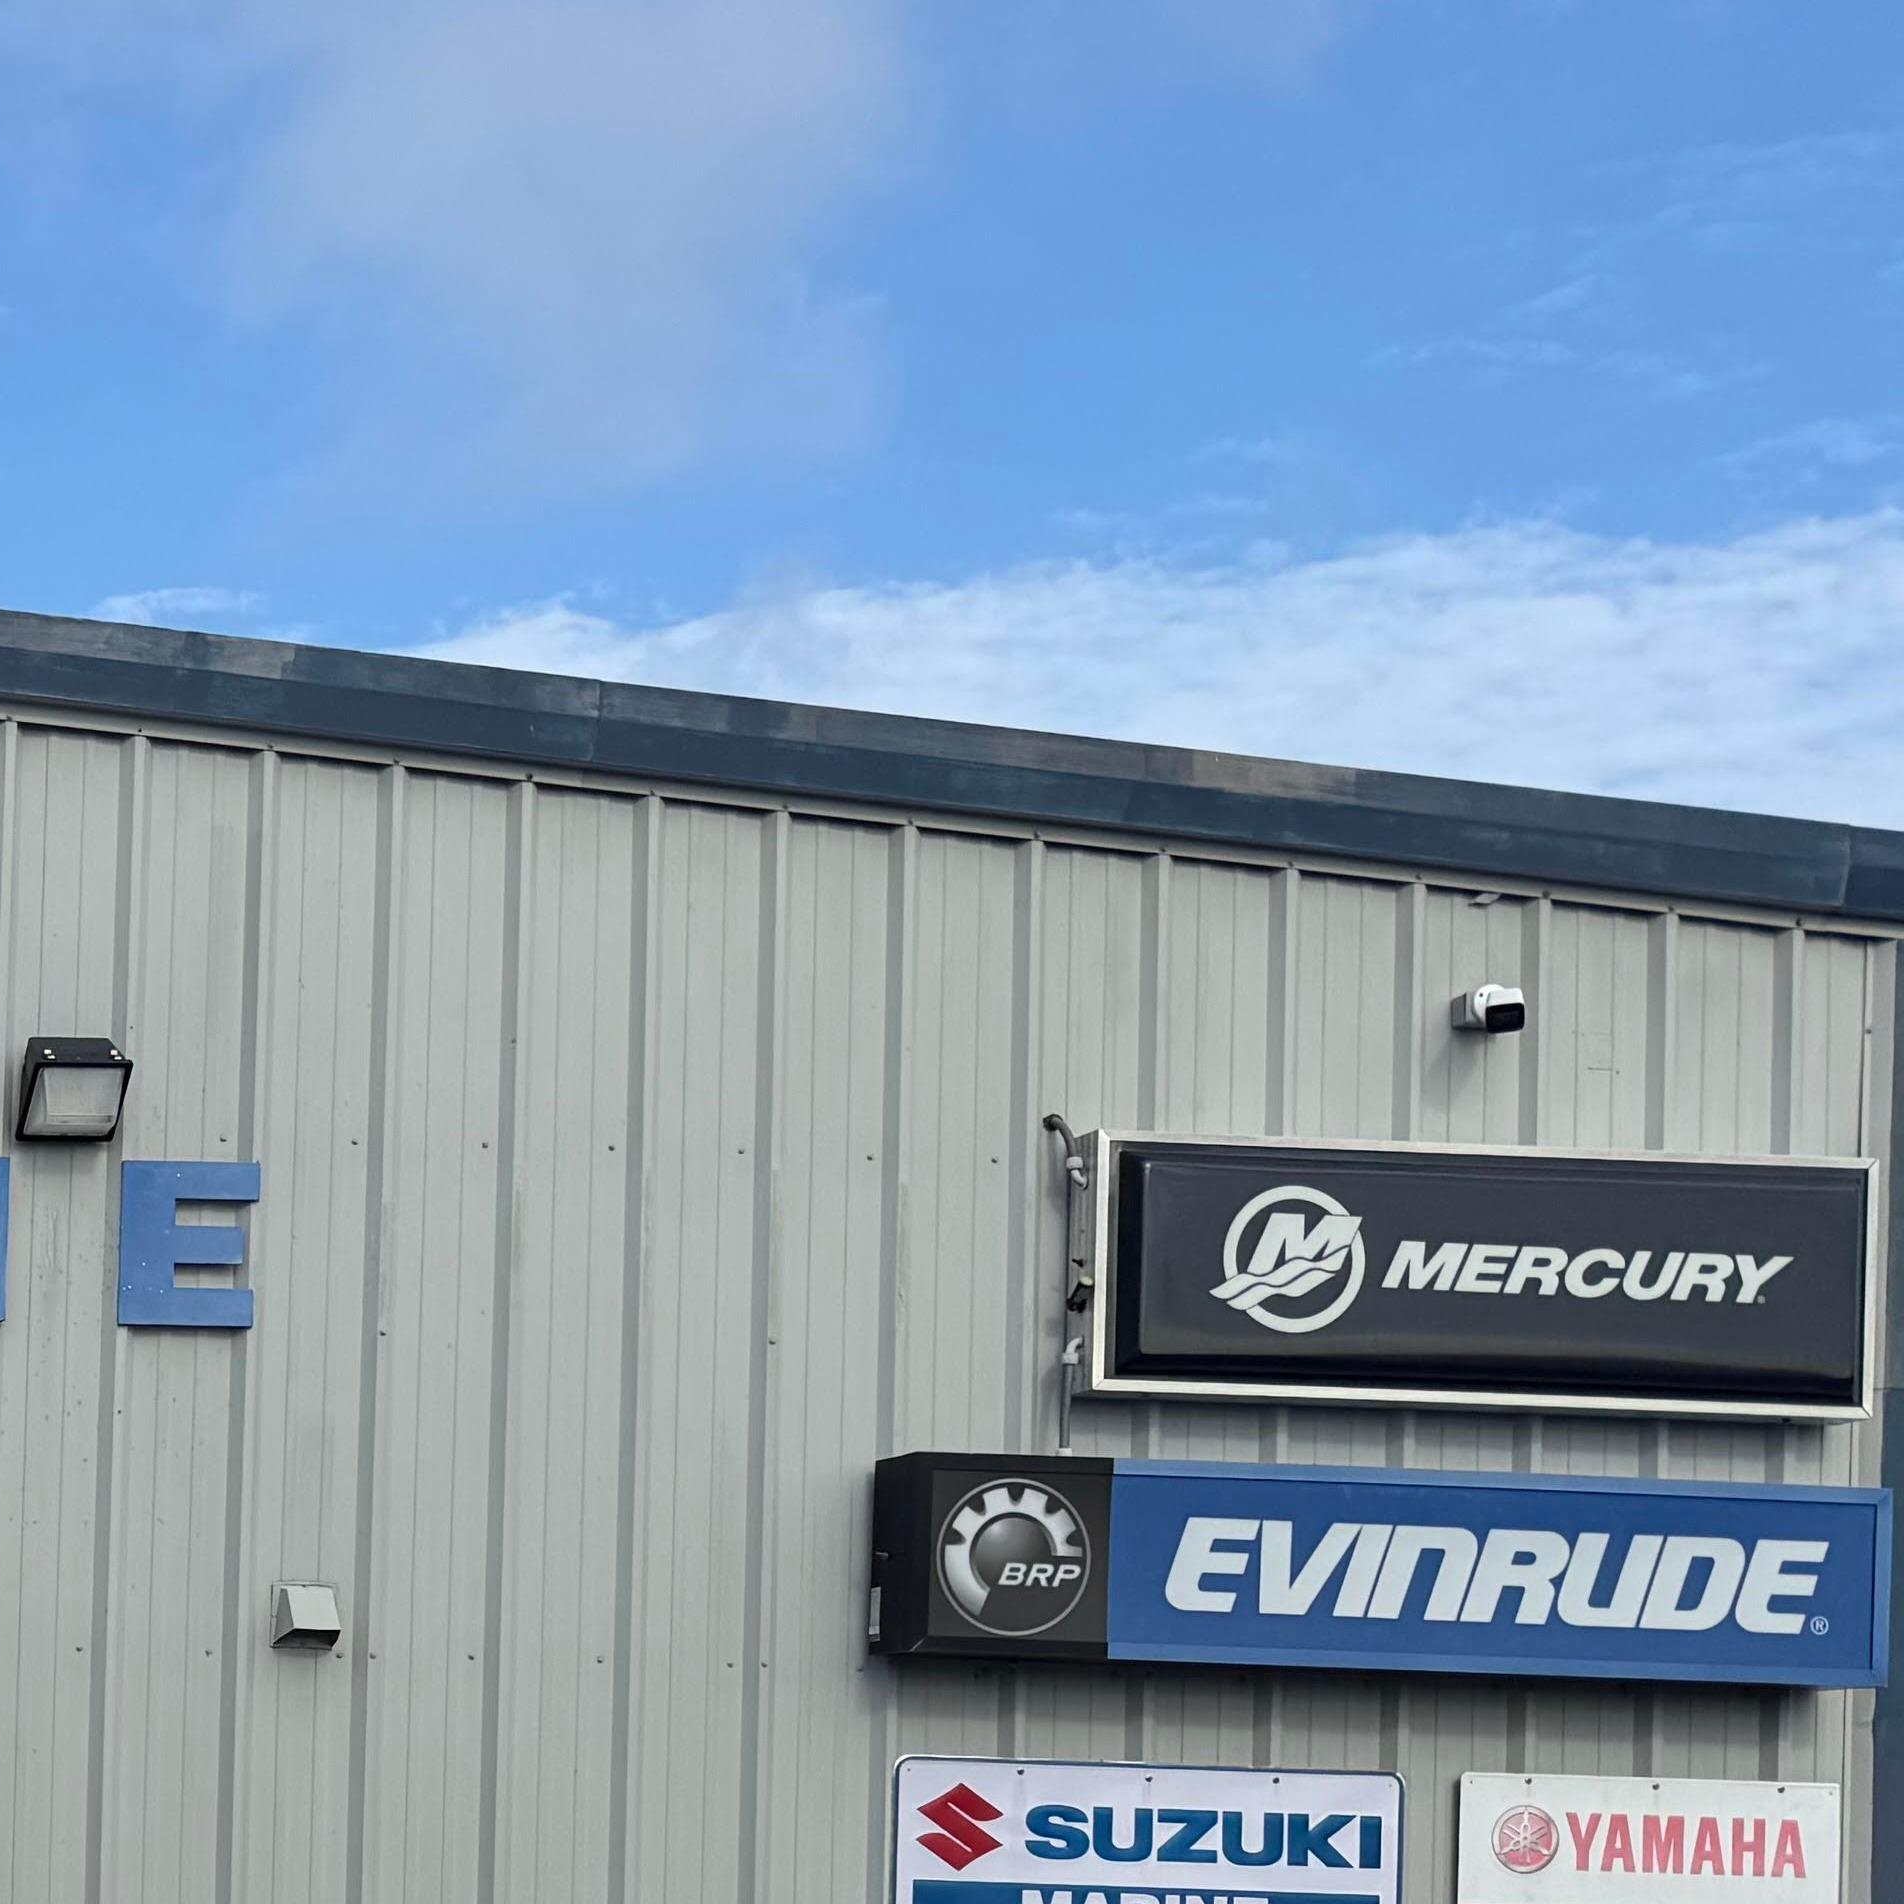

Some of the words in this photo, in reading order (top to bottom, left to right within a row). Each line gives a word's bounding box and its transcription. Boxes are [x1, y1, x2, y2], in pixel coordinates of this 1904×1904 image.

[1381, 1240, 1794, 1304] MERCURY
[997, 1562, 1082, 1588] BRP
[1164, 1516, 1830, 1635] EVINRUDE
[1024, 1804, 1383, 1869] SUZUKI
[1565, 1811, 1807, 1879] YAMAHA
